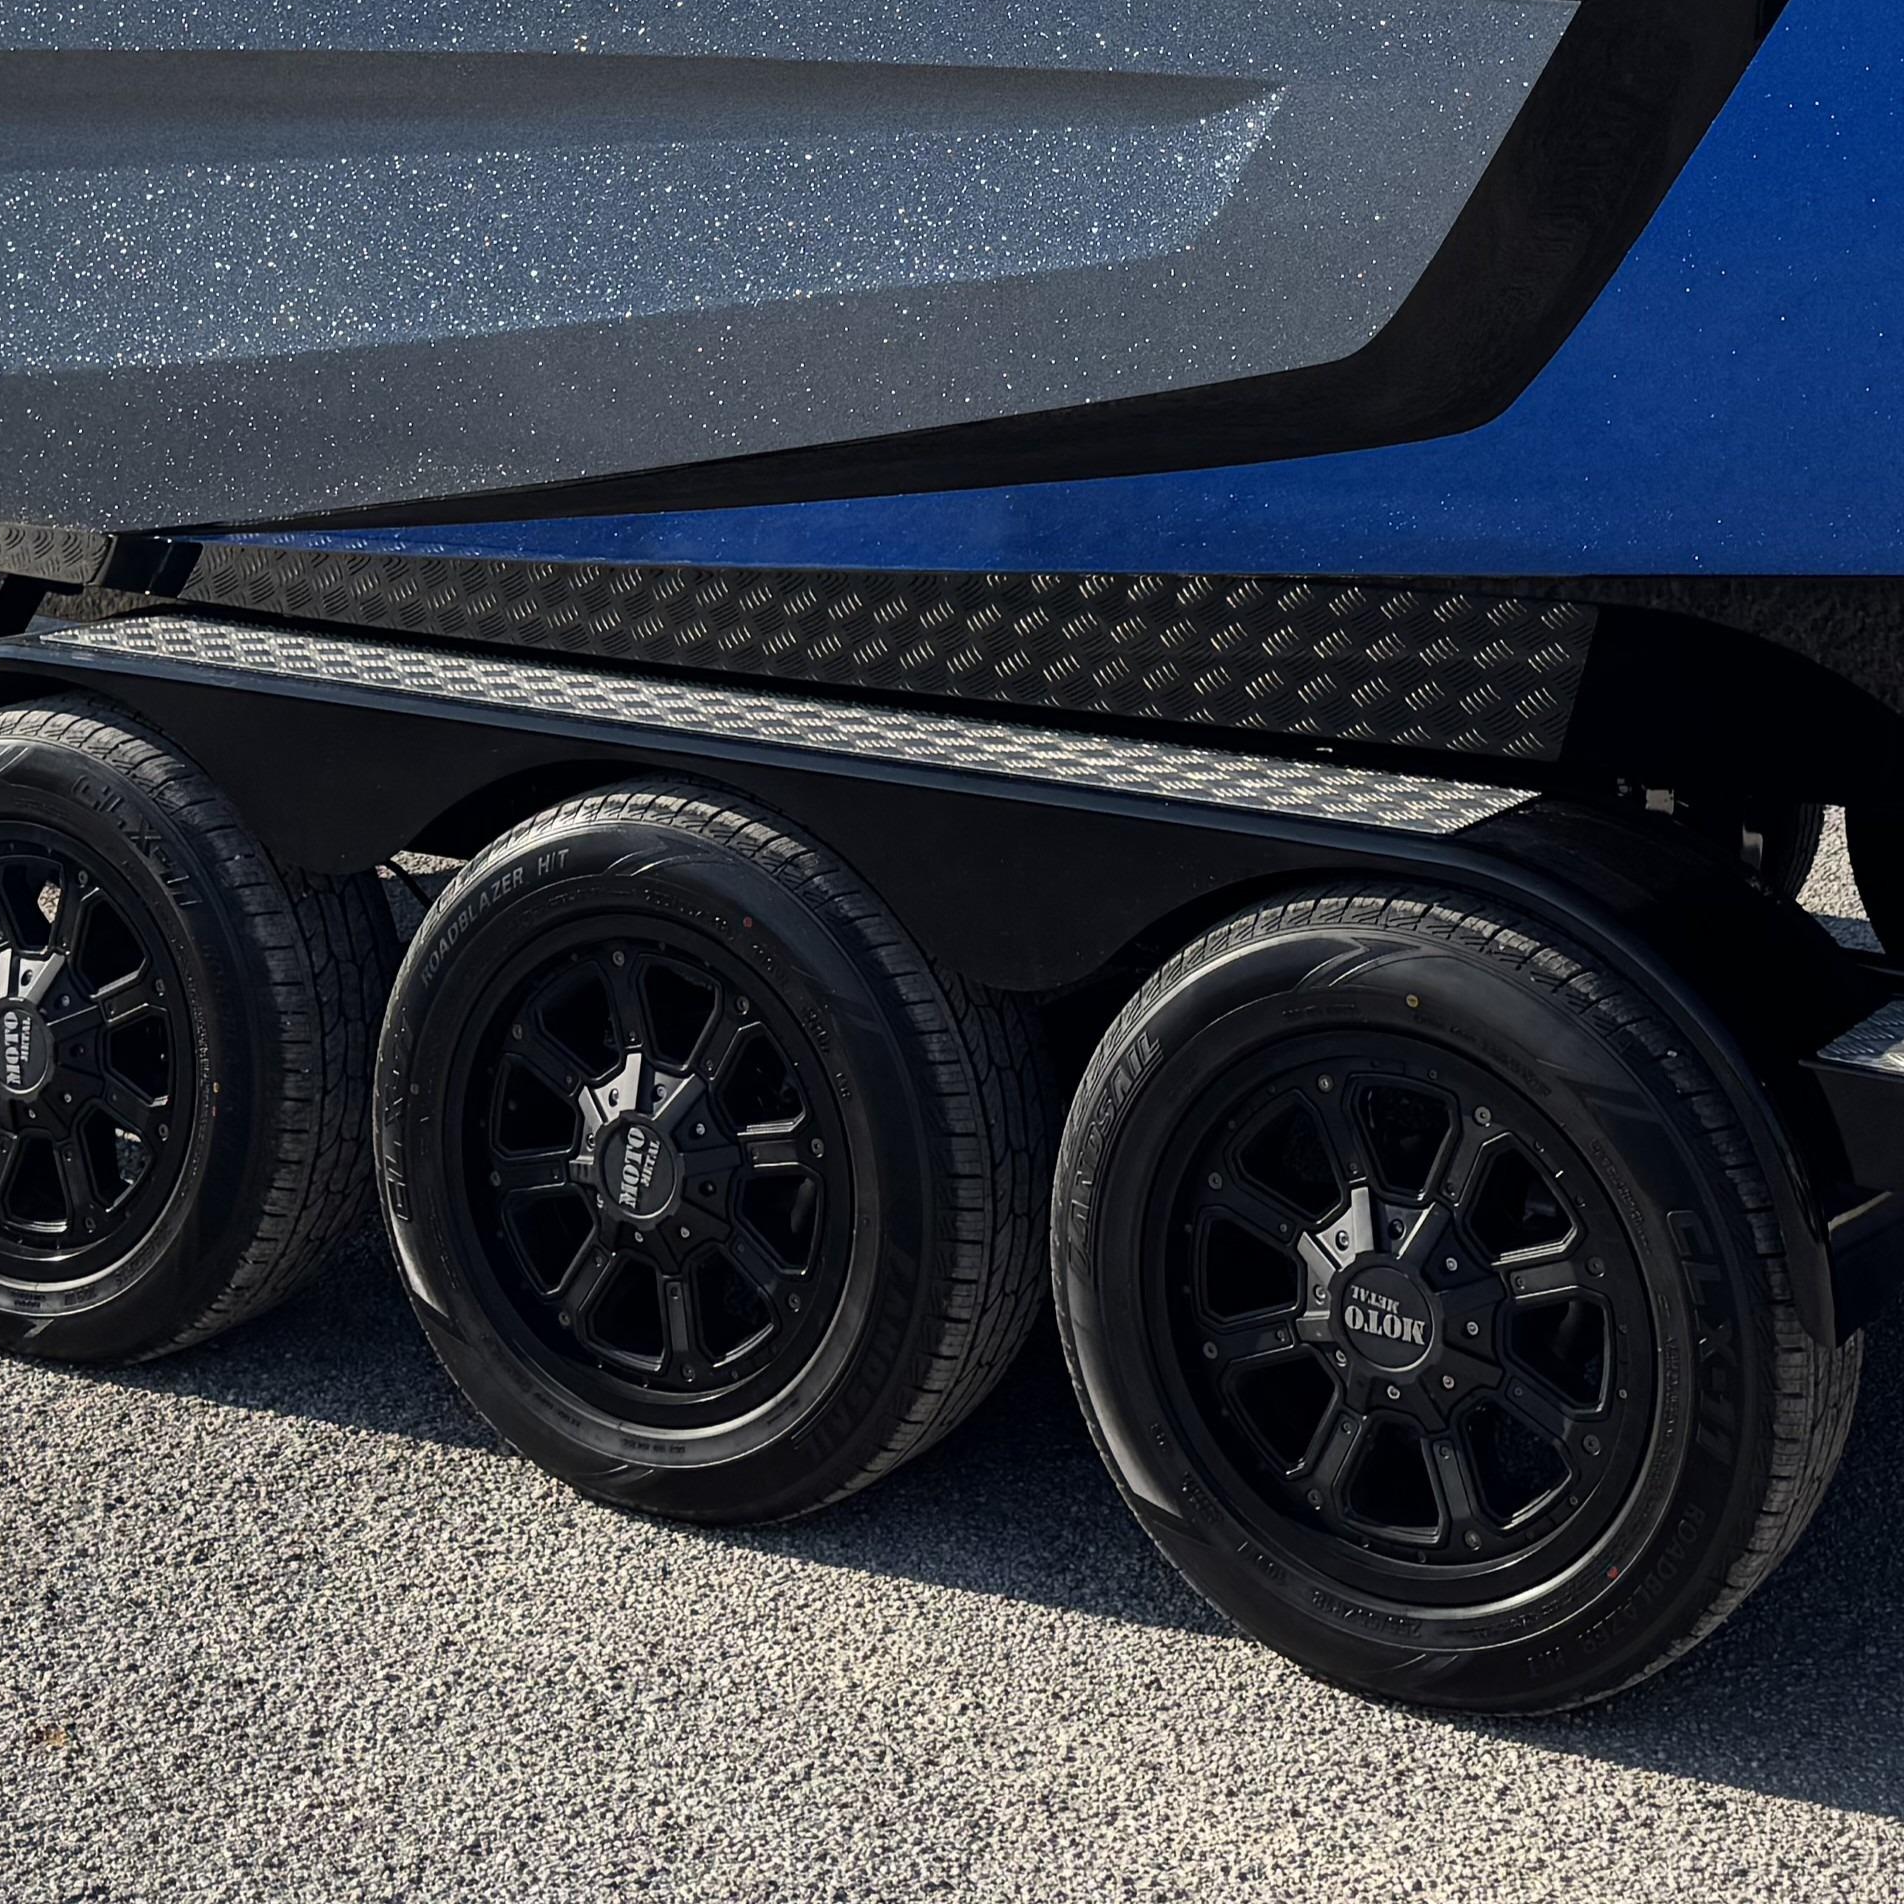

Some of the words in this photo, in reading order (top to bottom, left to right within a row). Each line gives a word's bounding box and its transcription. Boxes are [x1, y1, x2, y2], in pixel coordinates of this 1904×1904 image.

[420, 866, 525, 989] ROADBLAZER
[4, 1011, 21, 1085] MOTO
[619, 1127, 645, 1209] MOTO
[1344, 1305, 1426, 1345] MOTO
